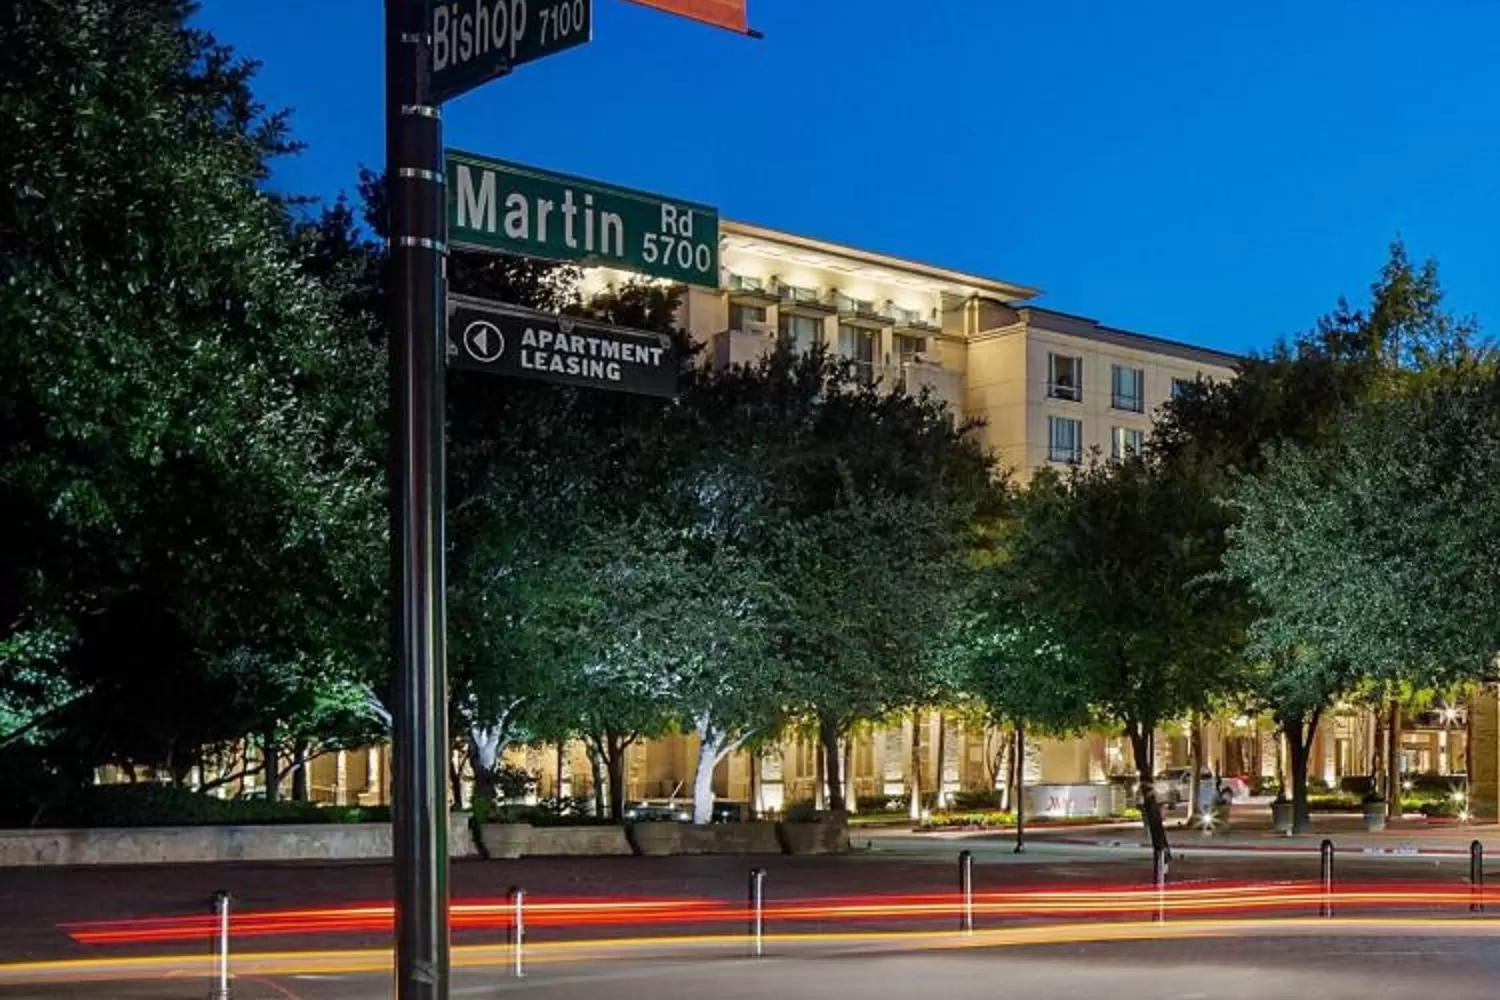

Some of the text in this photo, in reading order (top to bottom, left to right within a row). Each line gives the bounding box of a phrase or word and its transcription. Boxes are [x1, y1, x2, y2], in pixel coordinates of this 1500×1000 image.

[456, 164, 693, 257] Martin Rd
[641, 233, 712, 273] 5700
[520, 327, 664, 366] APARTMENT
[520, 349, 621, 381] LEASING
